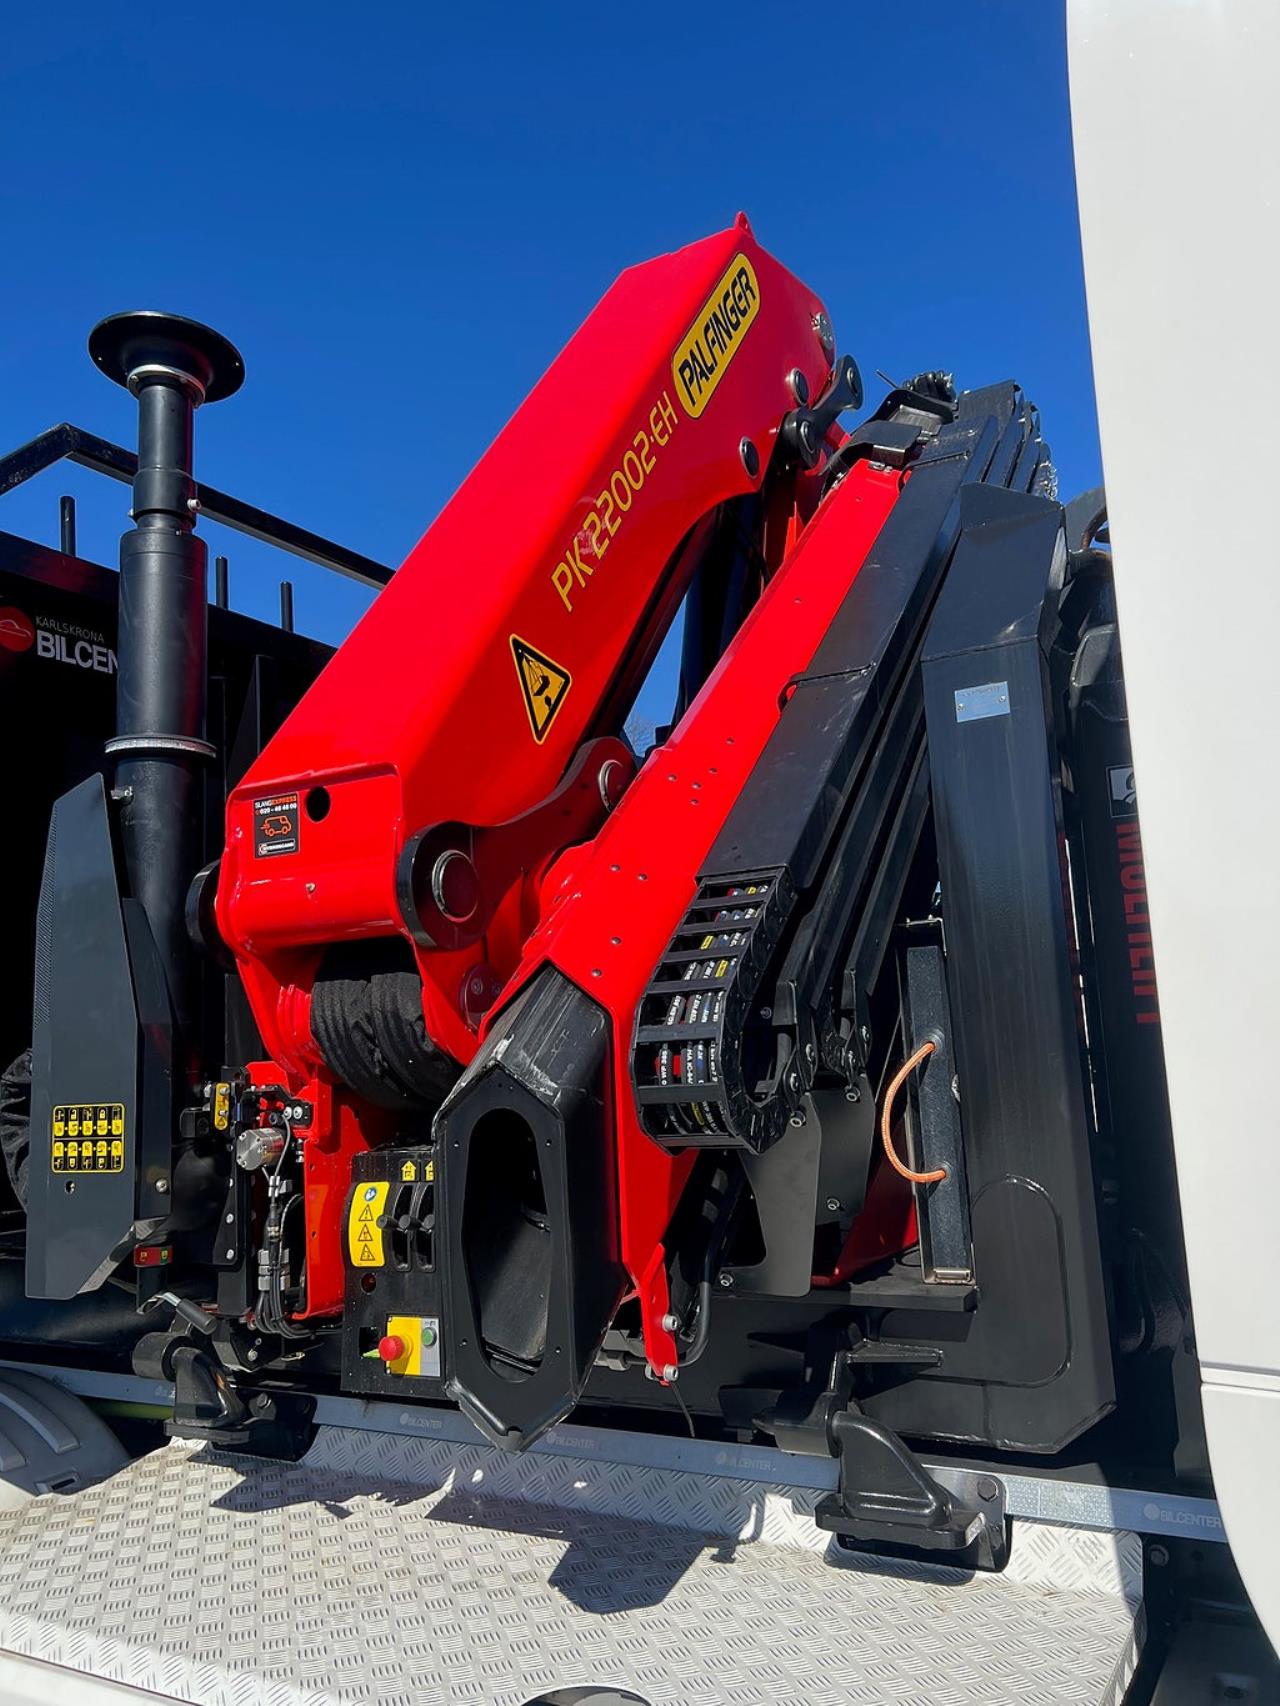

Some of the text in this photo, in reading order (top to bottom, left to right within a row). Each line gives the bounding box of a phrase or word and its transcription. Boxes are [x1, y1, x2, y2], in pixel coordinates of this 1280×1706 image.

[678, 266, 757, 406] PALFINGER
[35, 615, 105, 643] KARLSKRONA
[1160, 1510, 1221, 1529] BILCENTER
